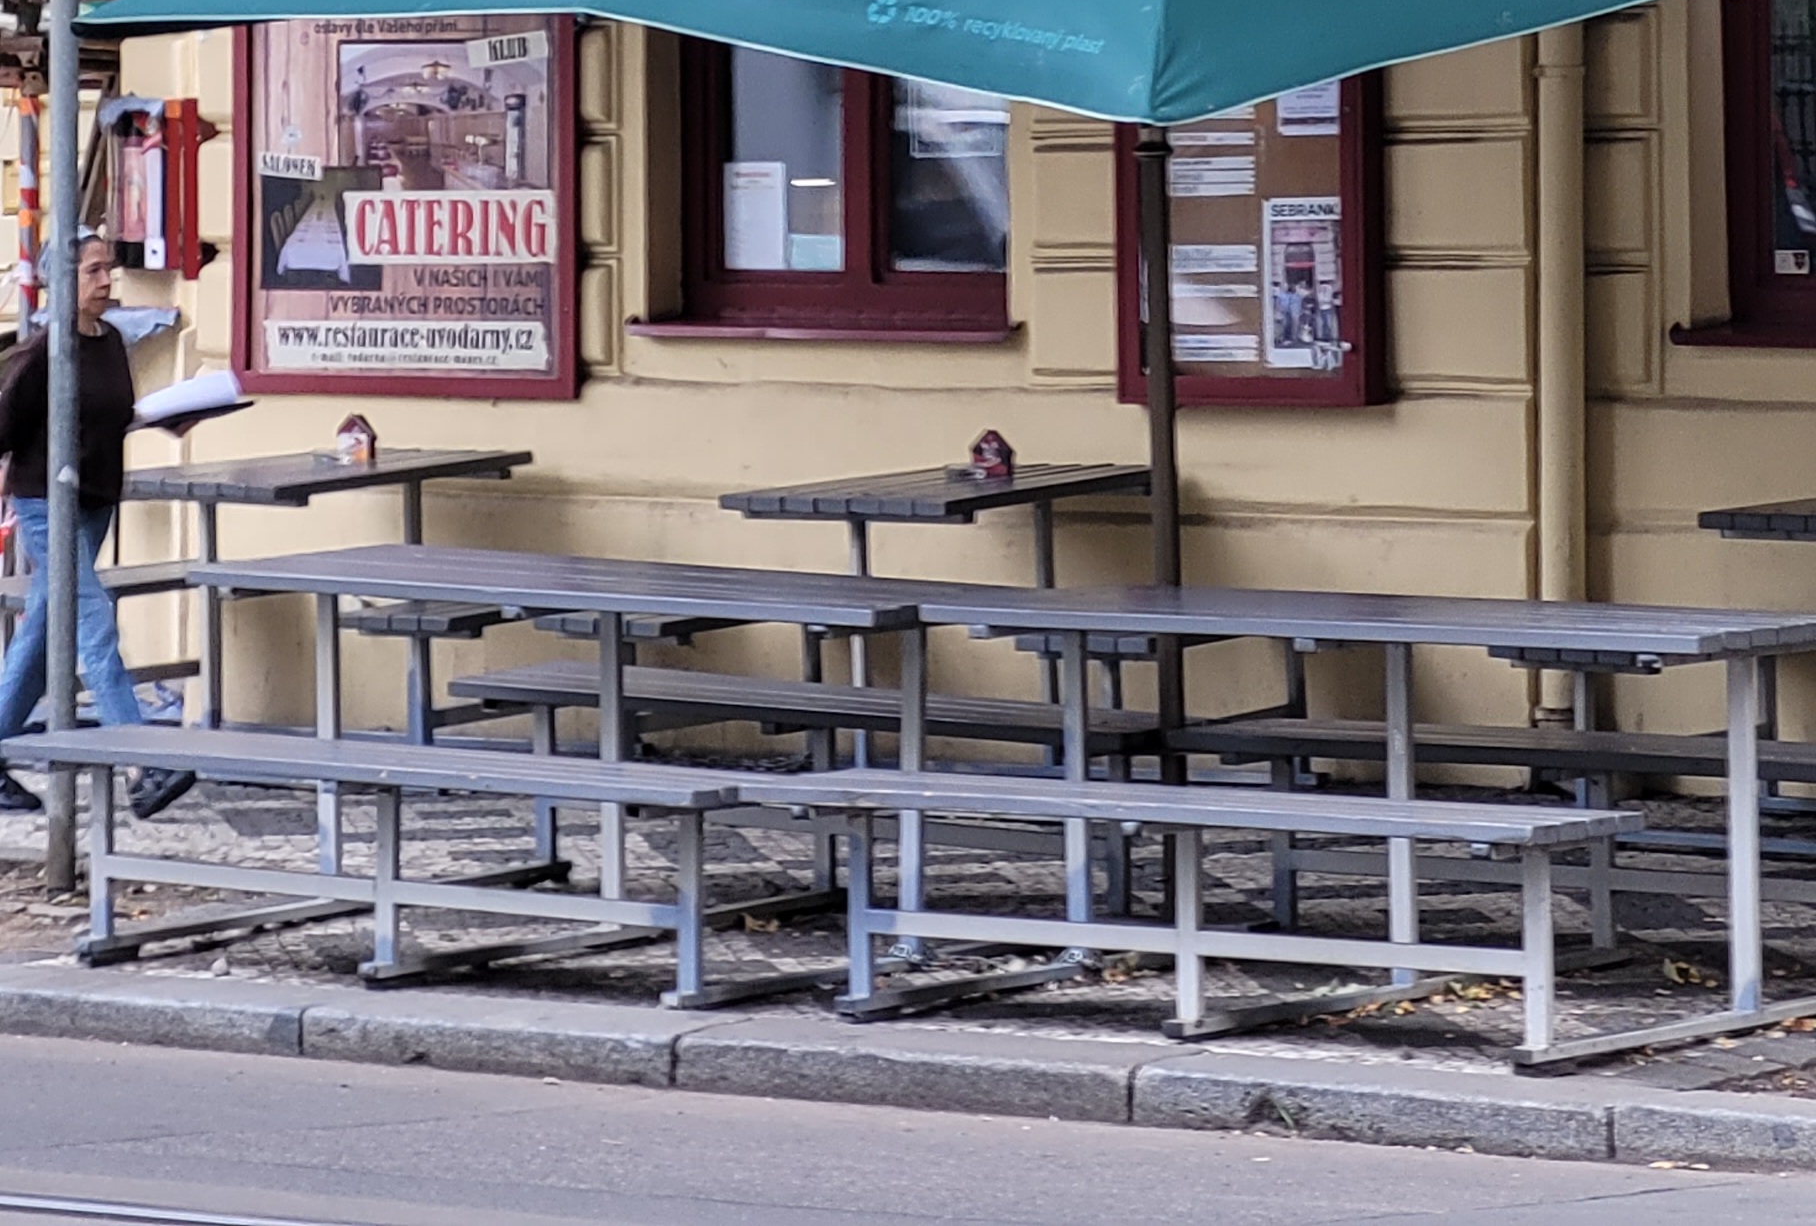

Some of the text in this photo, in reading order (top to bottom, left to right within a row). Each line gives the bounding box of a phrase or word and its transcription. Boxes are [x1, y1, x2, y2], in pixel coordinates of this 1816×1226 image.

[903, 5, 960, 30] 100%
[487, 36, 528, 62] KLUB
[354, 198, 548, 258] CATERING
[413, 268, 424, 286] V
[428, 266, 487, 288] NAŠICH
[329, 292, 545, 316] VYBRANÝCH PROSTORÁCH
[277, 323, 534, 354] www.restaurace-uvodarny.cz
